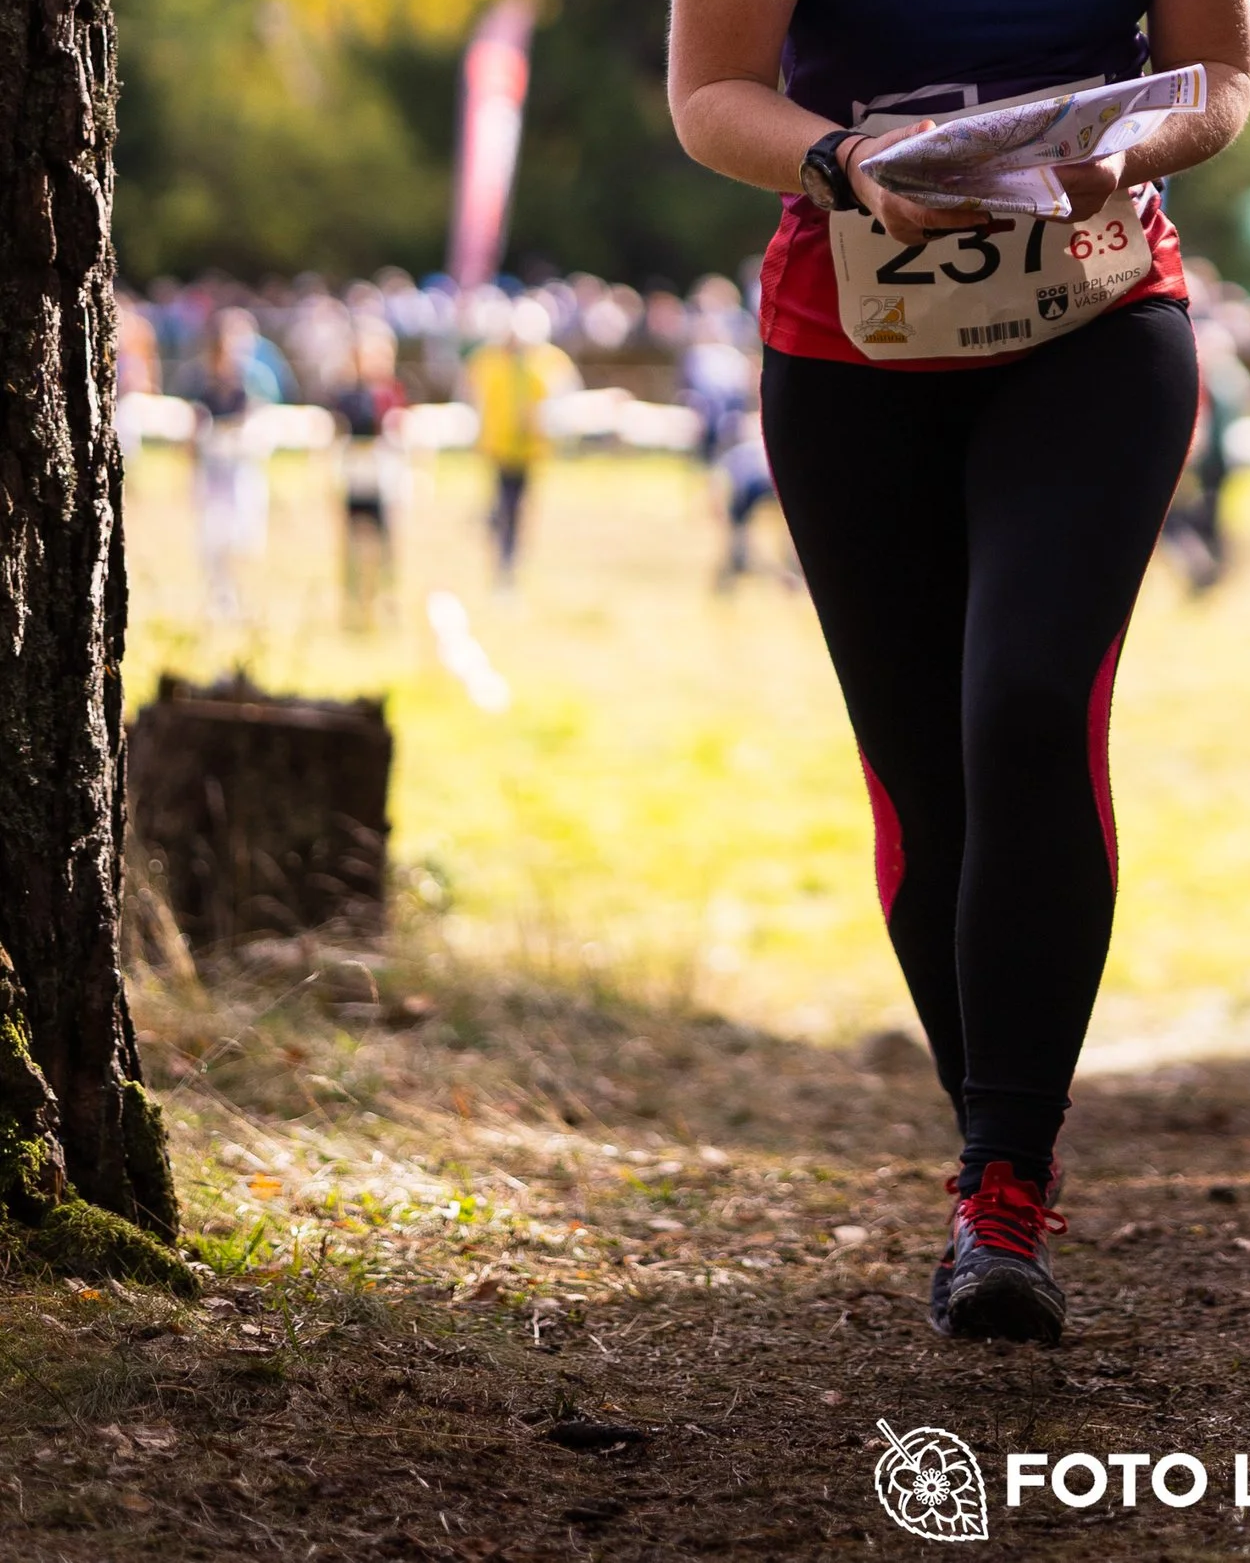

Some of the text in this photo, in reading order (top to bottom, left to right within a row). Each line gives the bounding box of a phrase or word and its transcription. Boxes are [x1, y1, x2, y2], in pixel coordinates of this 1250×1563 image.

[1070, 220, 1129, 260] 6:3
[1073, 267, 1142, 295] UPPLANDS
[862, 297, 903, 324] 25
[1073, 288, 1116, 309] VÄSBY
